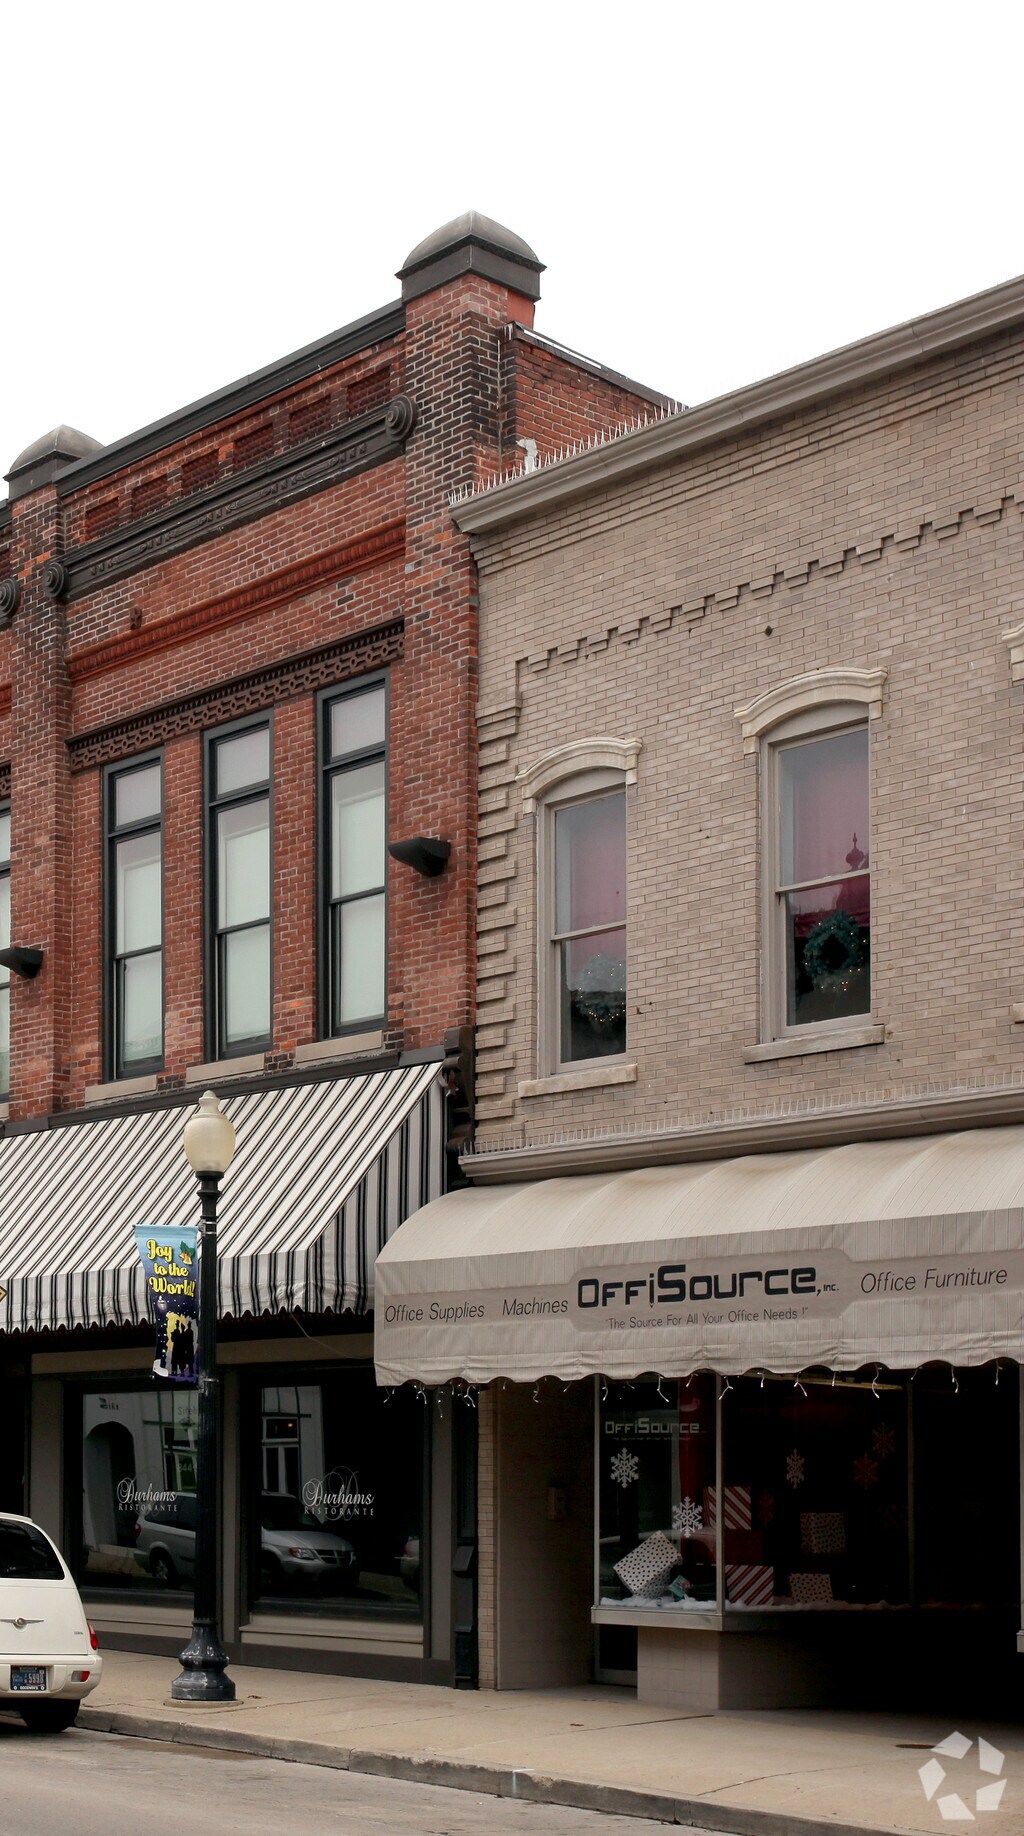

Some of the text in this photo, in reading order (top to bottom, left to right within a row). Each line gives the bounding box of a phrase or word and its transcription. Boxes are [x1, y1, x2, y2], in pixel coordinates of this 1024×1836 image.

[146, 1239, 173, 1262] Joy
[154, 1263, 188, 1276] to the
[861, 1267, 1007, 1293] Office Furniture
[149, 1276, 195, 1297] World!
[385, 1302, 485, 1323] Office Supplies
[502, 1298, 569, 1316] Machines
[629, 1316, 663, 1329] Source
[666, 1314, 682, 1326] For
[686, 1313, 699, 1324] All
[702, 1311, 724, 1324] Your
[728, 1309, 759, 1323] Office
[764, 1308, 798, 1321] Needs
[117, 1478, 177, 1503] Durhams
[302, 1478, 375, 1507] Durhams
[304, 1506, 374, 1516] RISTORANTE
